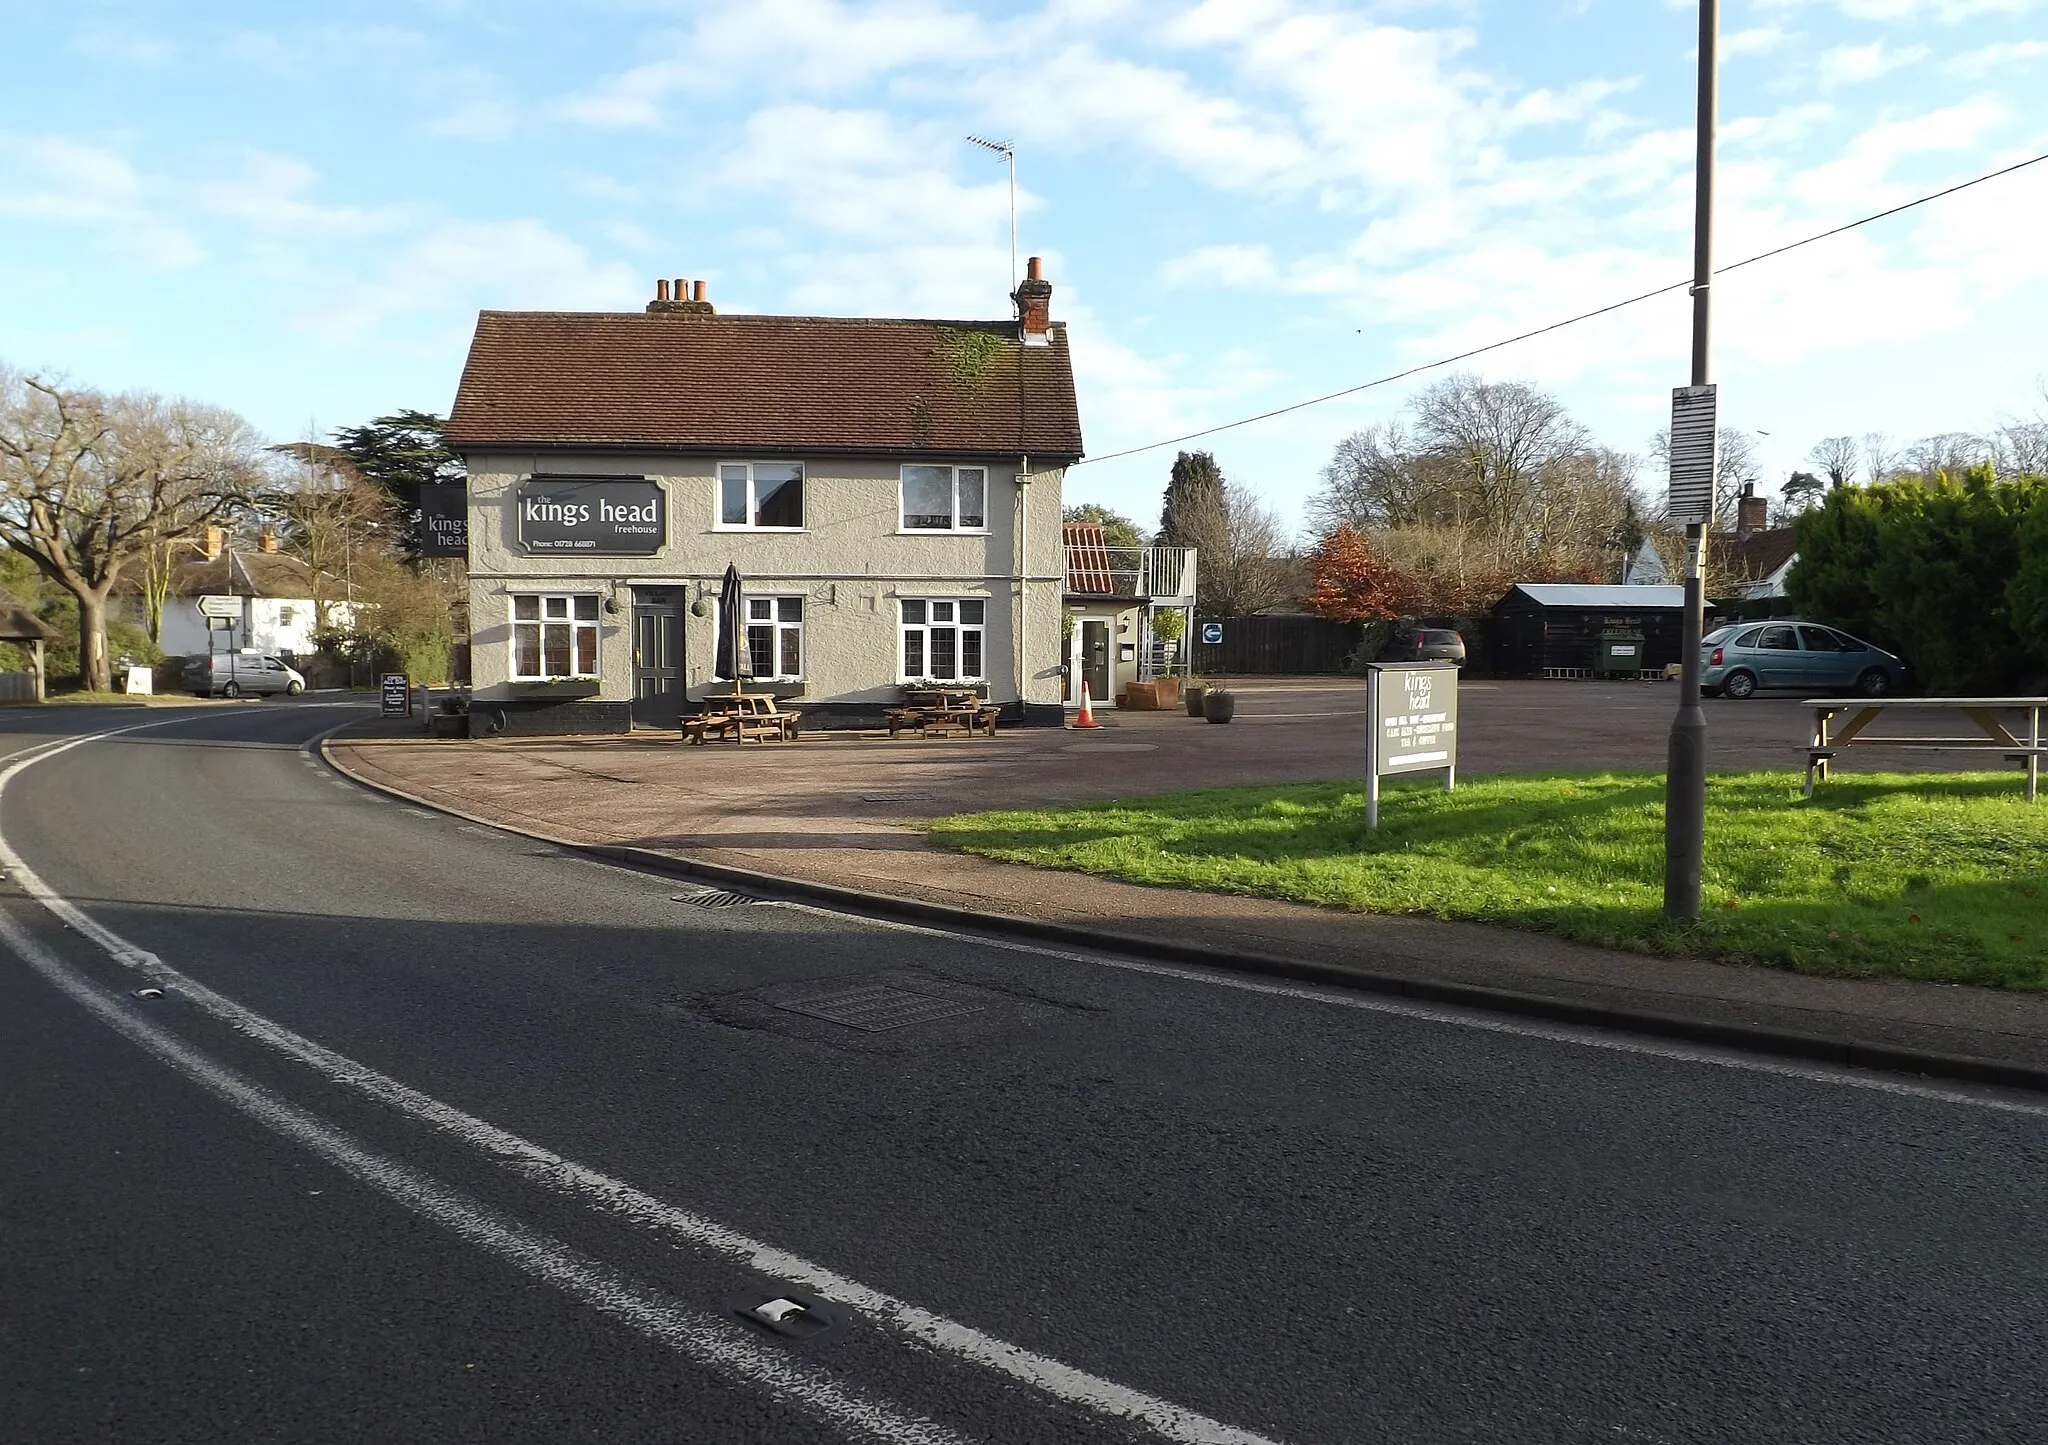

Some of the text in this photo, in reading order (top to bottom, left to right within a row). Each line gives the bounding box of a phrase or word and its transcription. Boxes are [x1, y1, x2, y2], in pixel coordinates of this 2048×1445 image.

[538, 495, 551, 503] the
[526, 498, 657, 526] kings head
[429, 516, 468, 534] kings
[614, 525, 657, 533] freehouse
[1404, 672, 1432, 696] kings
[1408, 691, 1431, 710] head
